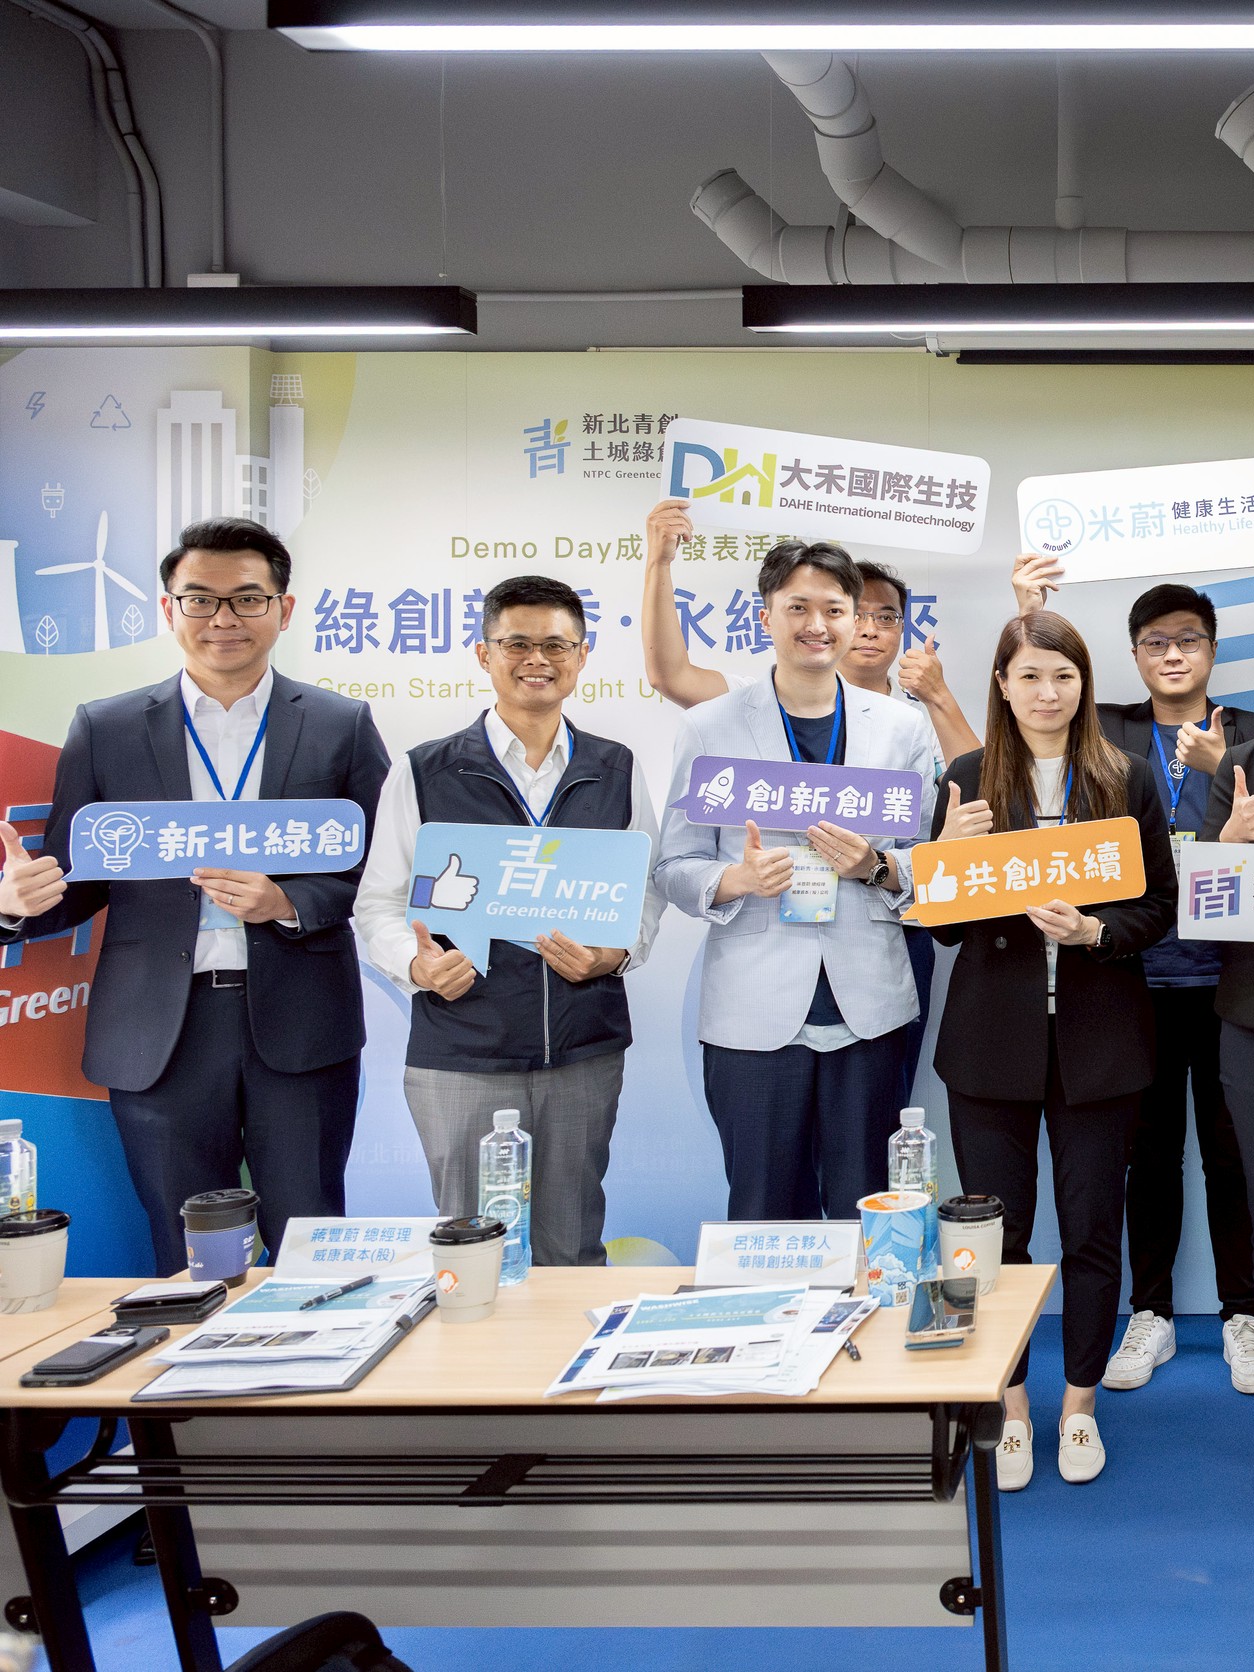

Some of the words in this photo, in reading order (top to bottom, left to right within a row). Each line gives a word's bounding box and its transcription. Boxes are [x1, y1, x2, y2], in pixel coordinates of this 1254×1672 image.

[583, 470, 611, 479] NTPC
[615, 470, 661, 479] Greentec
[779, 458, 978, 512] 大禾國際生技
[779, 497, 813, 512] DAHE
[815, 502, 892, 522] International
[893, 511, 975, 533] Biotechnology
[1087, 502, 1167, 542] 米蔚
[1172, 519, 1225, 536] Healthy
[1228, 516, 1254, 531] Life
[450, 536, 538, 560] Demo
[1042, 539, 1073, 552] MIDWAY
[746, 778, 914, 824] 創新創業
[156, 817, 360, 863] 新北綠創
[963, 840, 1122, 898] 共創永續
[554, 879, 628, 903] NTPC
[485, 901, 579, 921] Greentech
[583, 908, 620, 923] Hub
[0, 980, 91, 1028] Green
[310, 1227, 360, 1243] 蔣豐蔚
[362, 1227, 412, 1242] 總經理
[733, 1235, 780, 1251] 呂湘柔
[786, 1235, 831, 1251] 合夥人
[312, 1247, 396, 1263] 威康資本(股)
[737, 1254, 824, 1269] 華陽創投集團
